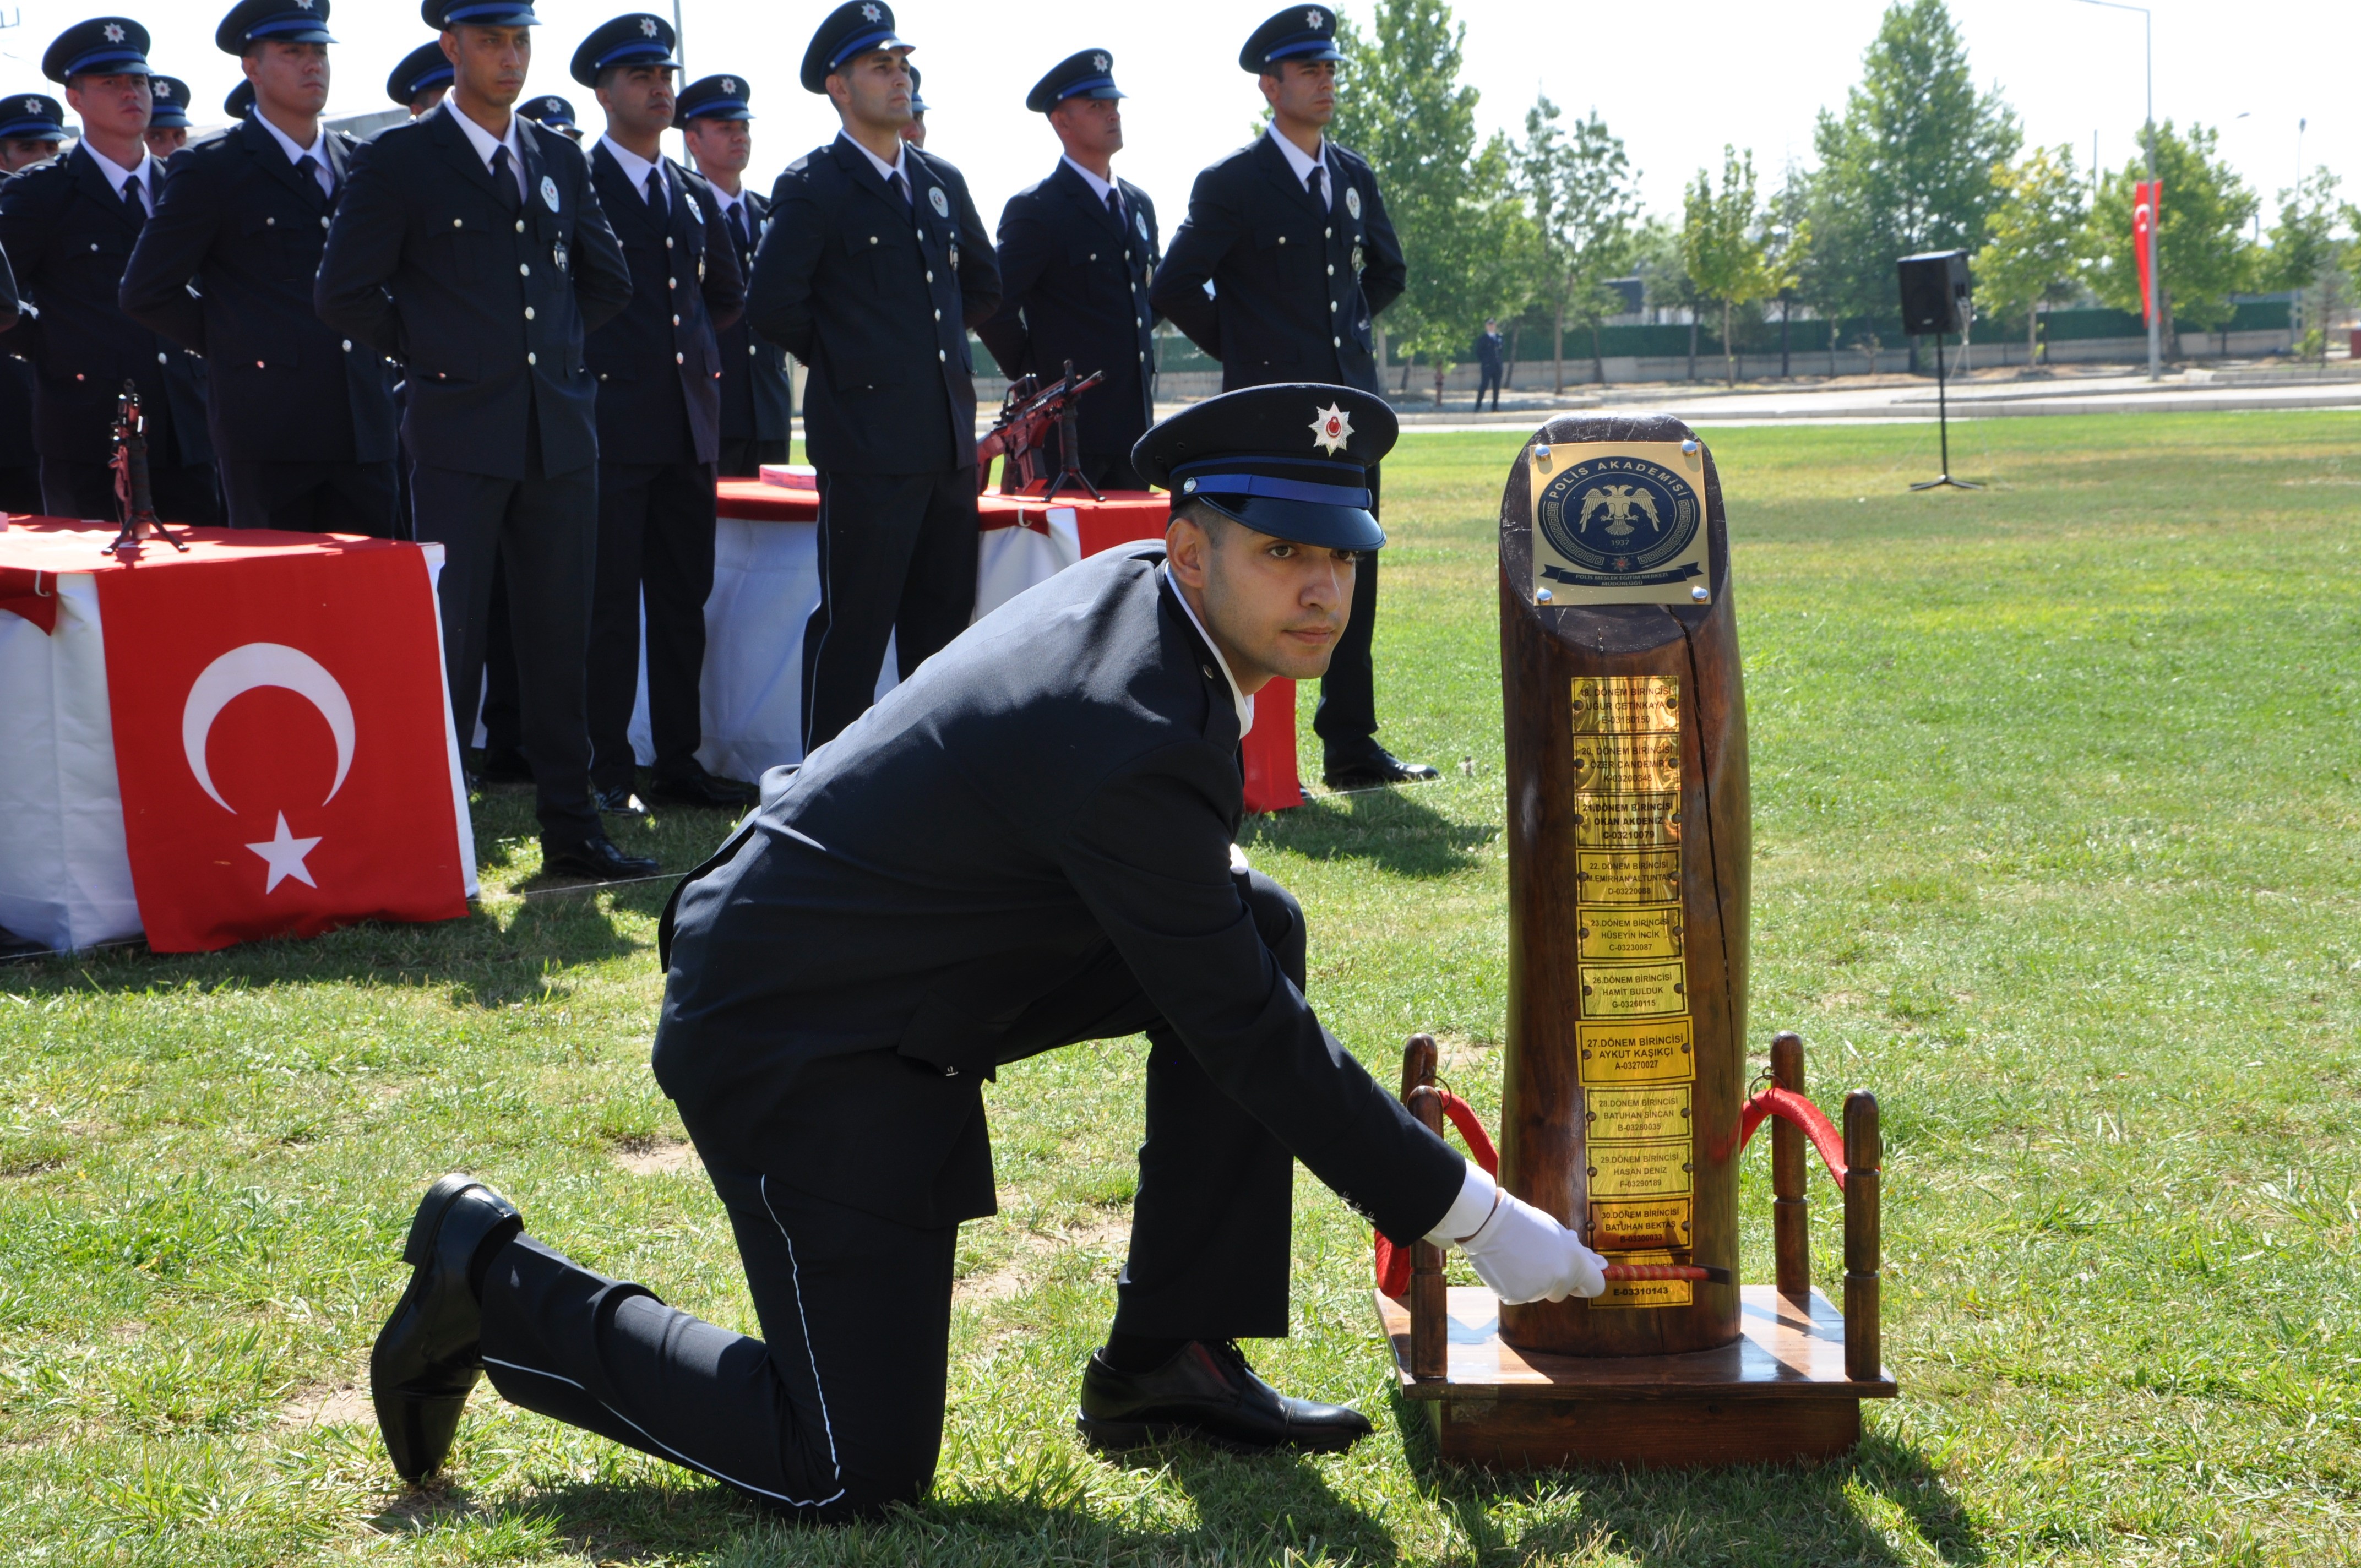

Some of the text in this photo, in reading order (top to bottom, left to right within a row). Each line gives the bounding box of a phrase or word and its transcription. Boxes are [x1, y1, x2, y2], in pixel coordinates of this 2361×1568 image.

[1548, 461, 1690, 498] POLİS AKADEMİSİ
[1594, 687, 1628, 696] DÖNEM
[1630, 685, 1671, 696] BİRİNCİSİ
[1586, 700, 1666, 710] UĞUR ÇETİNKAYA
[1602, 716, 1650, 724] E-03180150
[1597, 745, 1630, 755] DÖNEM
[1633, 744, 1673, 755] BİRİNCİSİ
[1590, 759, 1664, 769] ÖZER CANDEMİR
[1631, 801, 1673, 812] BİRİNCİSİ
[1623, 815, 1663, 825] AKDENİZ
[1603, 831, 1655, 839] C-03210079
[1602, 861, 1630, 870] DÖNEM
[1633, 859, 1668, 869] BİRİNCİSİ
[1587, 872, 1632, 882] M.EMİRHAN
[1633, 918, 1669, 927] BİRİNCİSİ
[1601, 929, 1660, 939] HÜSEYİN İNCİK
[1635, 972, 1672, 983] BİRİNCİSİ
[1602, 987, 1663, 996] HAMİT BULDUK
[1612, 1000, 1656, 1008] G-03260115
[1639, 1033, 1683, 1046] BİRİNCİSİ
[1599, 1047, 1673, 1059] AYKUT KAŞIKÇI
[1614, 1060, 1658, 1070] A-03270027
[1641, 1096, 1678, 1106] BİRİNCİSİ
[1644, 1110, 1674, 1118] SİNCAN
[1618, 1123, 1661, 1131] B-03280035
[1643, 1152, 1679, 1162] BİRİNCİSİ
[1620, 1179, 1662, 1188] F-03290189
[1644, 1207, 1679, 1217] BİRİNCİSİ
[1606, 1223, 1643, 1231] BATUHAN
[1620, 1234, 1662, 1243] B-03300033
[1613, 1287, 1668, 1296] E-03310143
